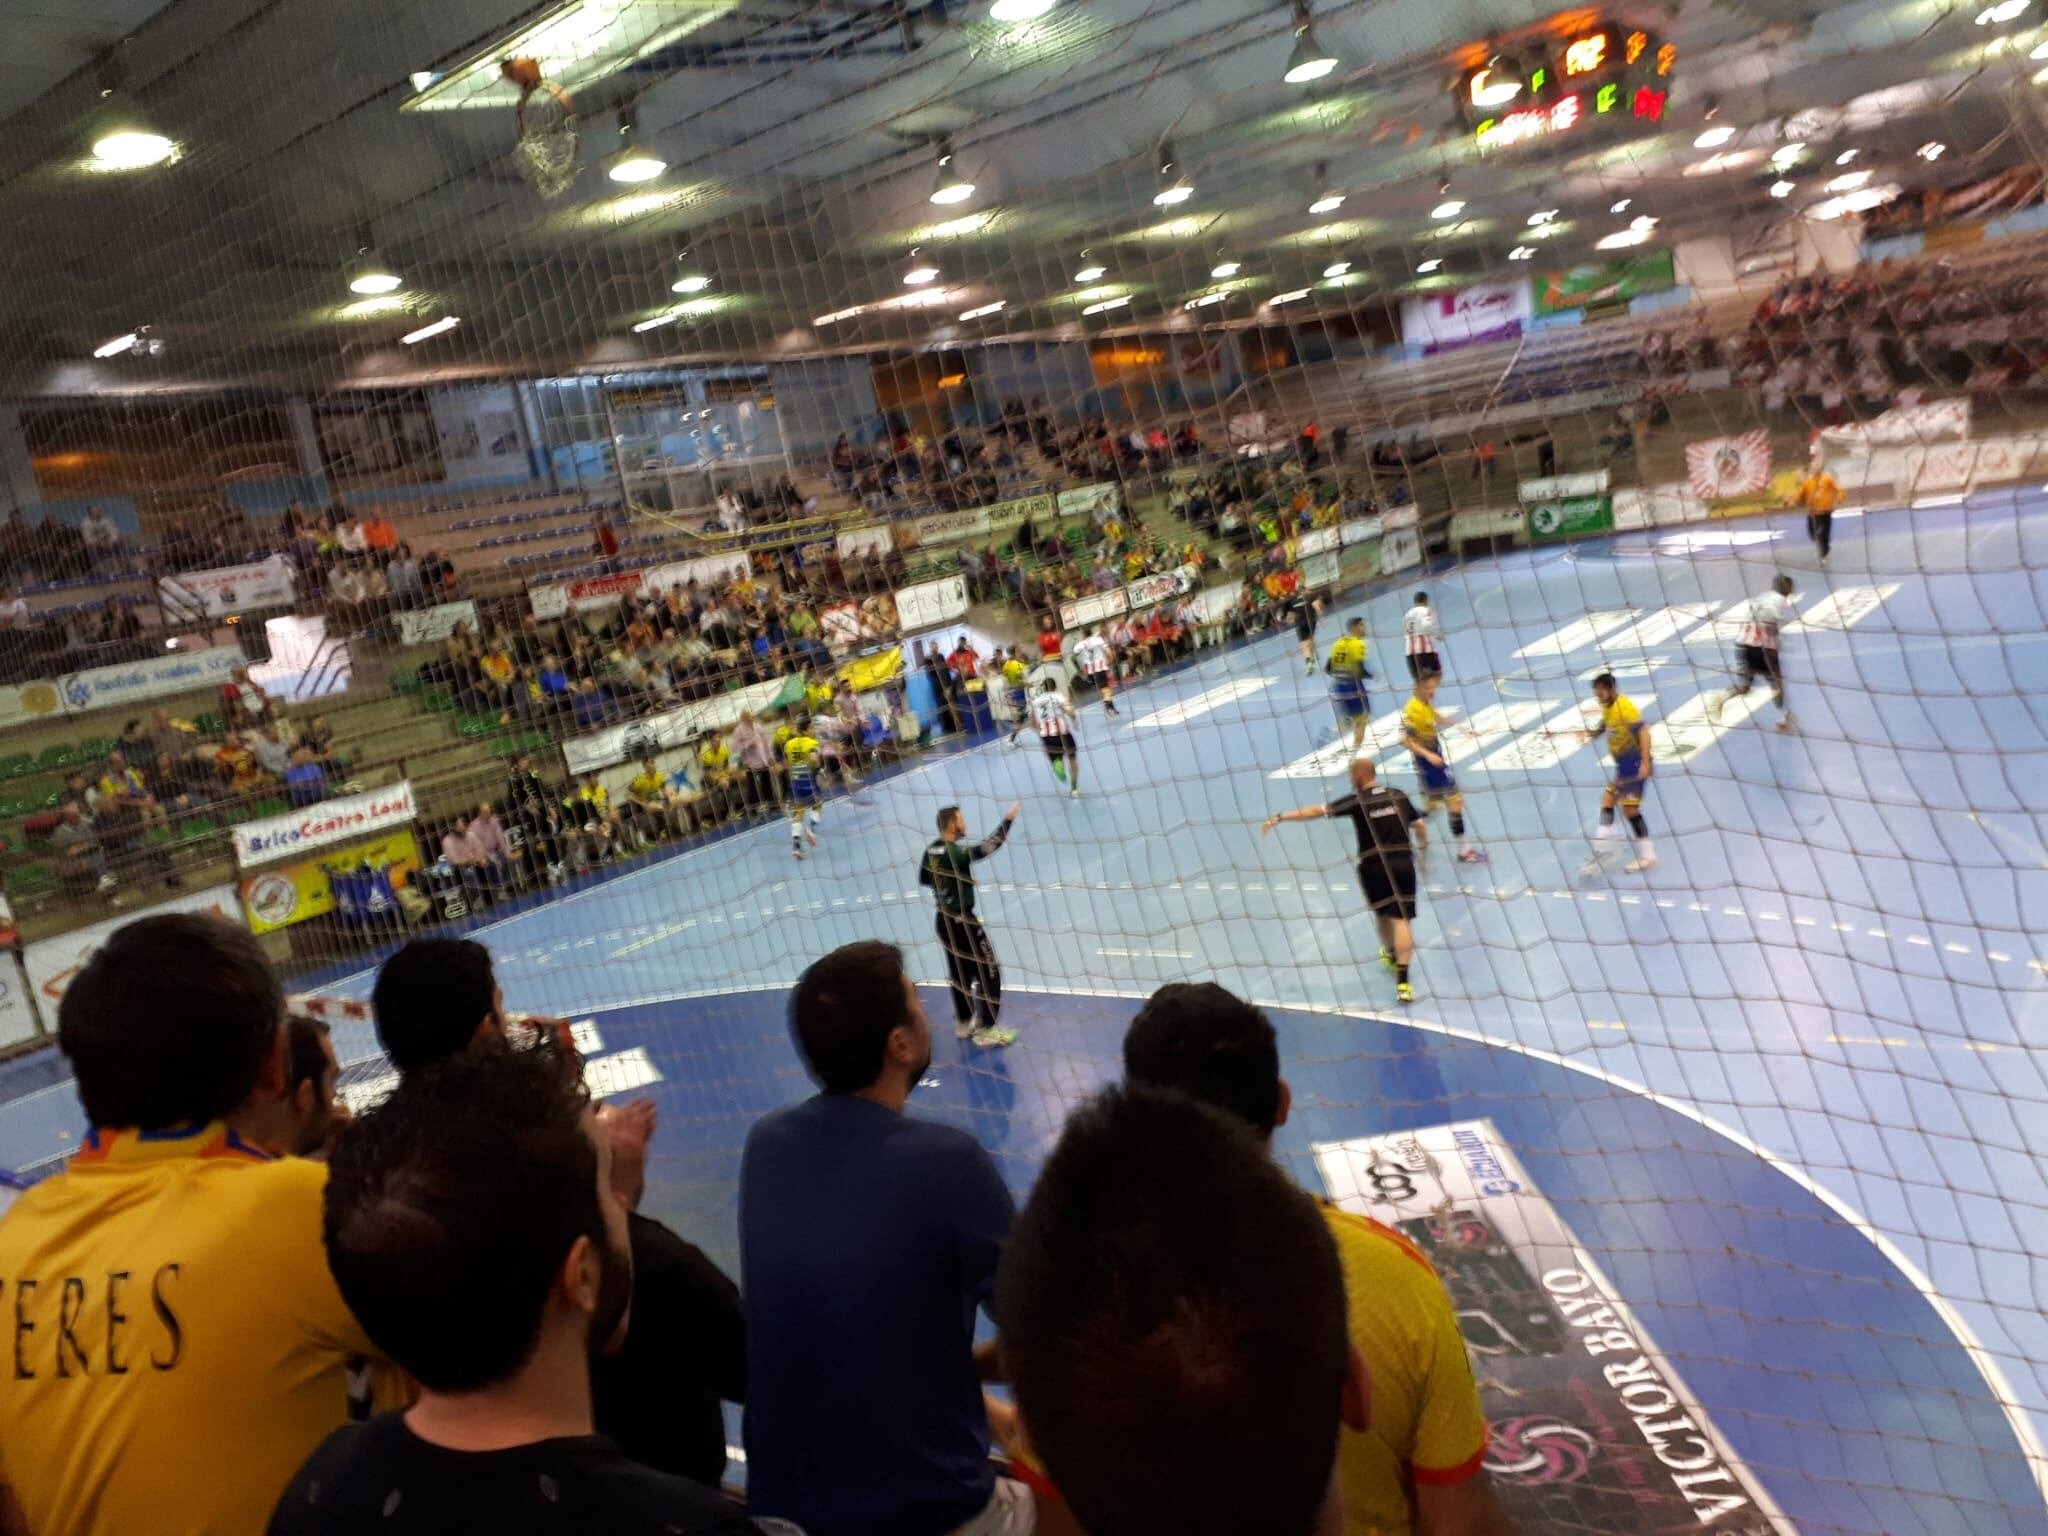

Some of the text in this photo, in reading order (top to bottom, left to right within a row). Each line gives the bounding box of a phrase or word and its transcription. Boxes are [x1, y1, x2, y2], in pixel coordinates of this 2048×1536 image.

[0, 1262, 183, 1380] ERES
[1541, 1268, 1641, 1357] BAYO
[1602, 1355, 1749, 1525] VICTOR
